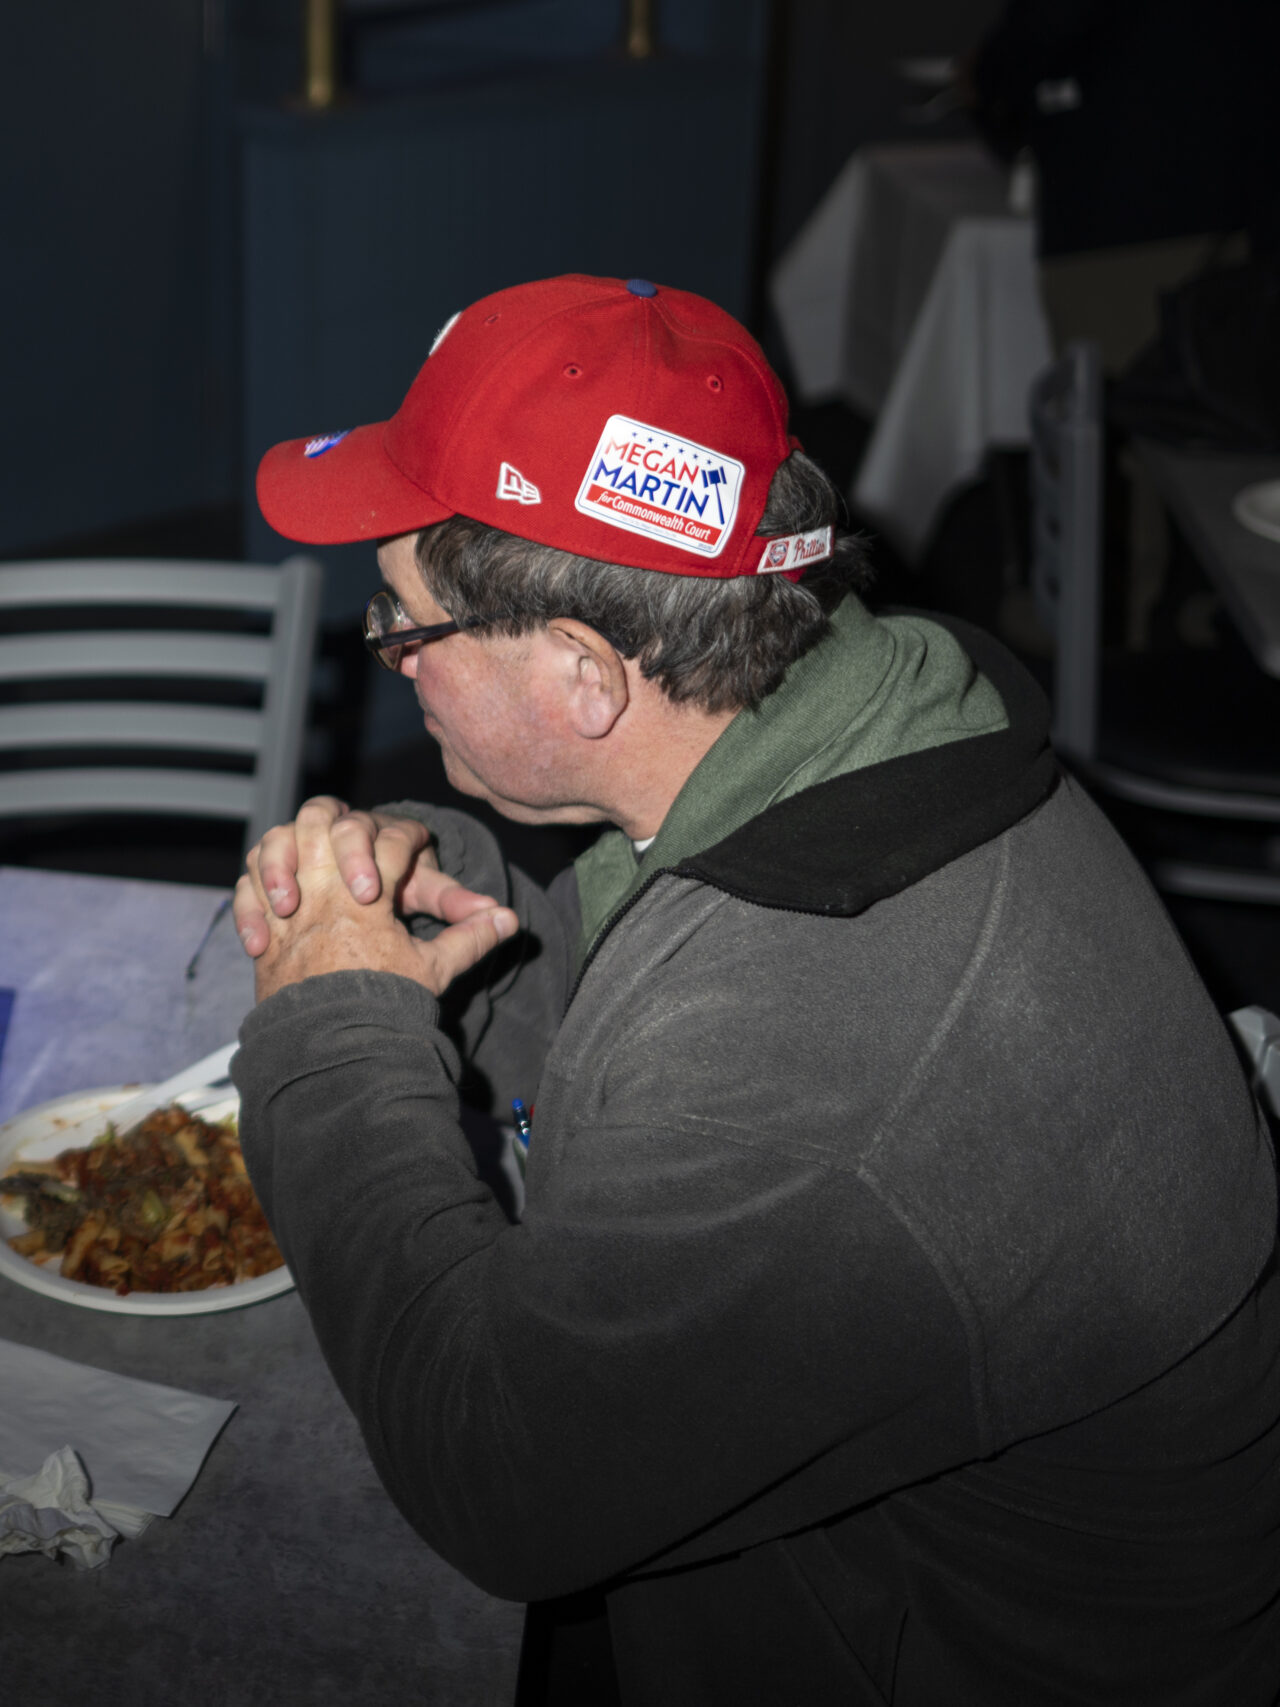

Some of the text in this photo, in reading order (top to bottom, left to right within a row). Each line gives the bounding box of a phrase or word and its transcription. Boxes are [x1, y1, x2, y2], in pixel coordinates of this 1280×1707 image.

[604, 436, 700, 484] MEGAN
[593, 458, 710, 518] MARTIN
[612, 495, 685, 531] Commonwealth
[684, 521, 712, 541] Court
